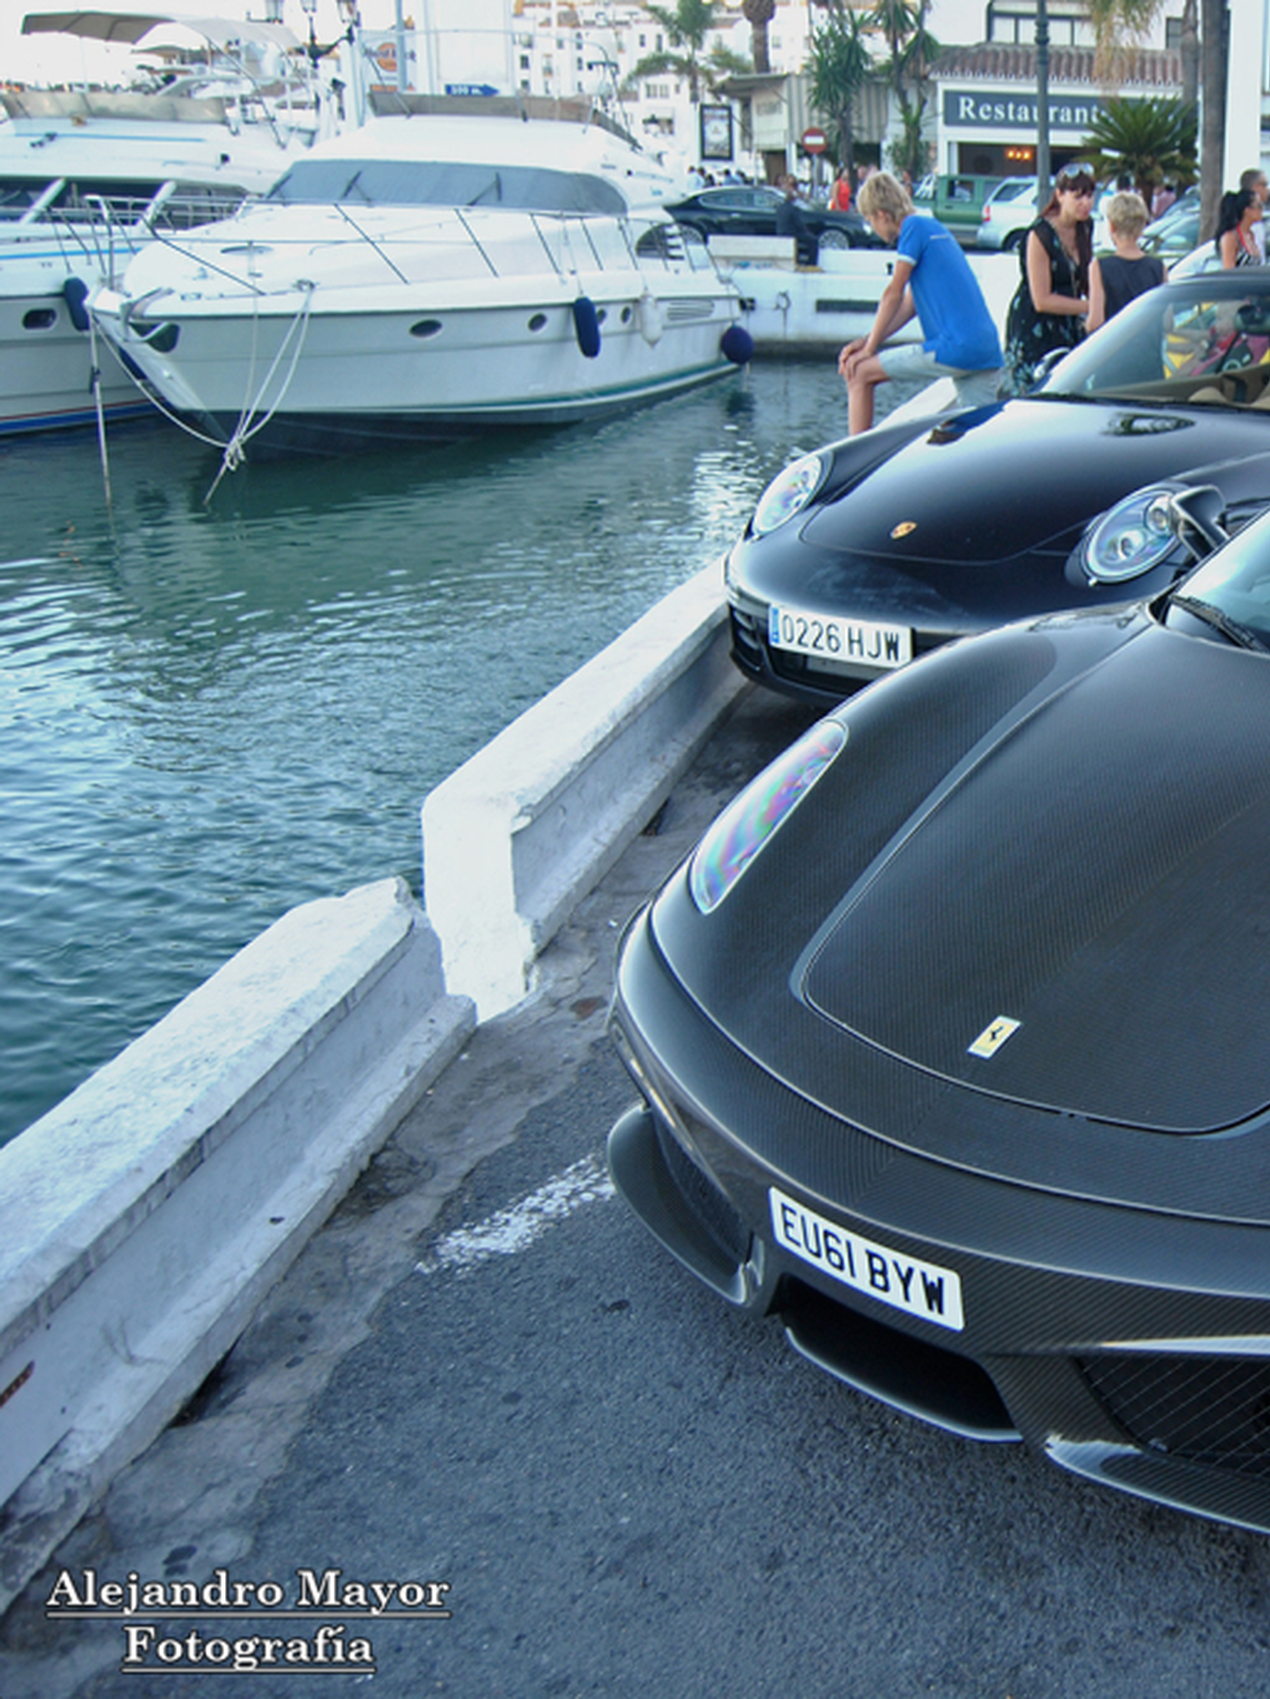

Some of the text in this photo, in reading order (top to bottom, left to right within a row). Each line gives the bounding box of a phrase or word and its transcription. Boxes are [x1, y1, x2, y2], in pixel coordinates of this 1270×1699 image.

[782, 614, 900, 662] 0226 HJW
[781, 1202, 945, 1316] EU61 BYW
